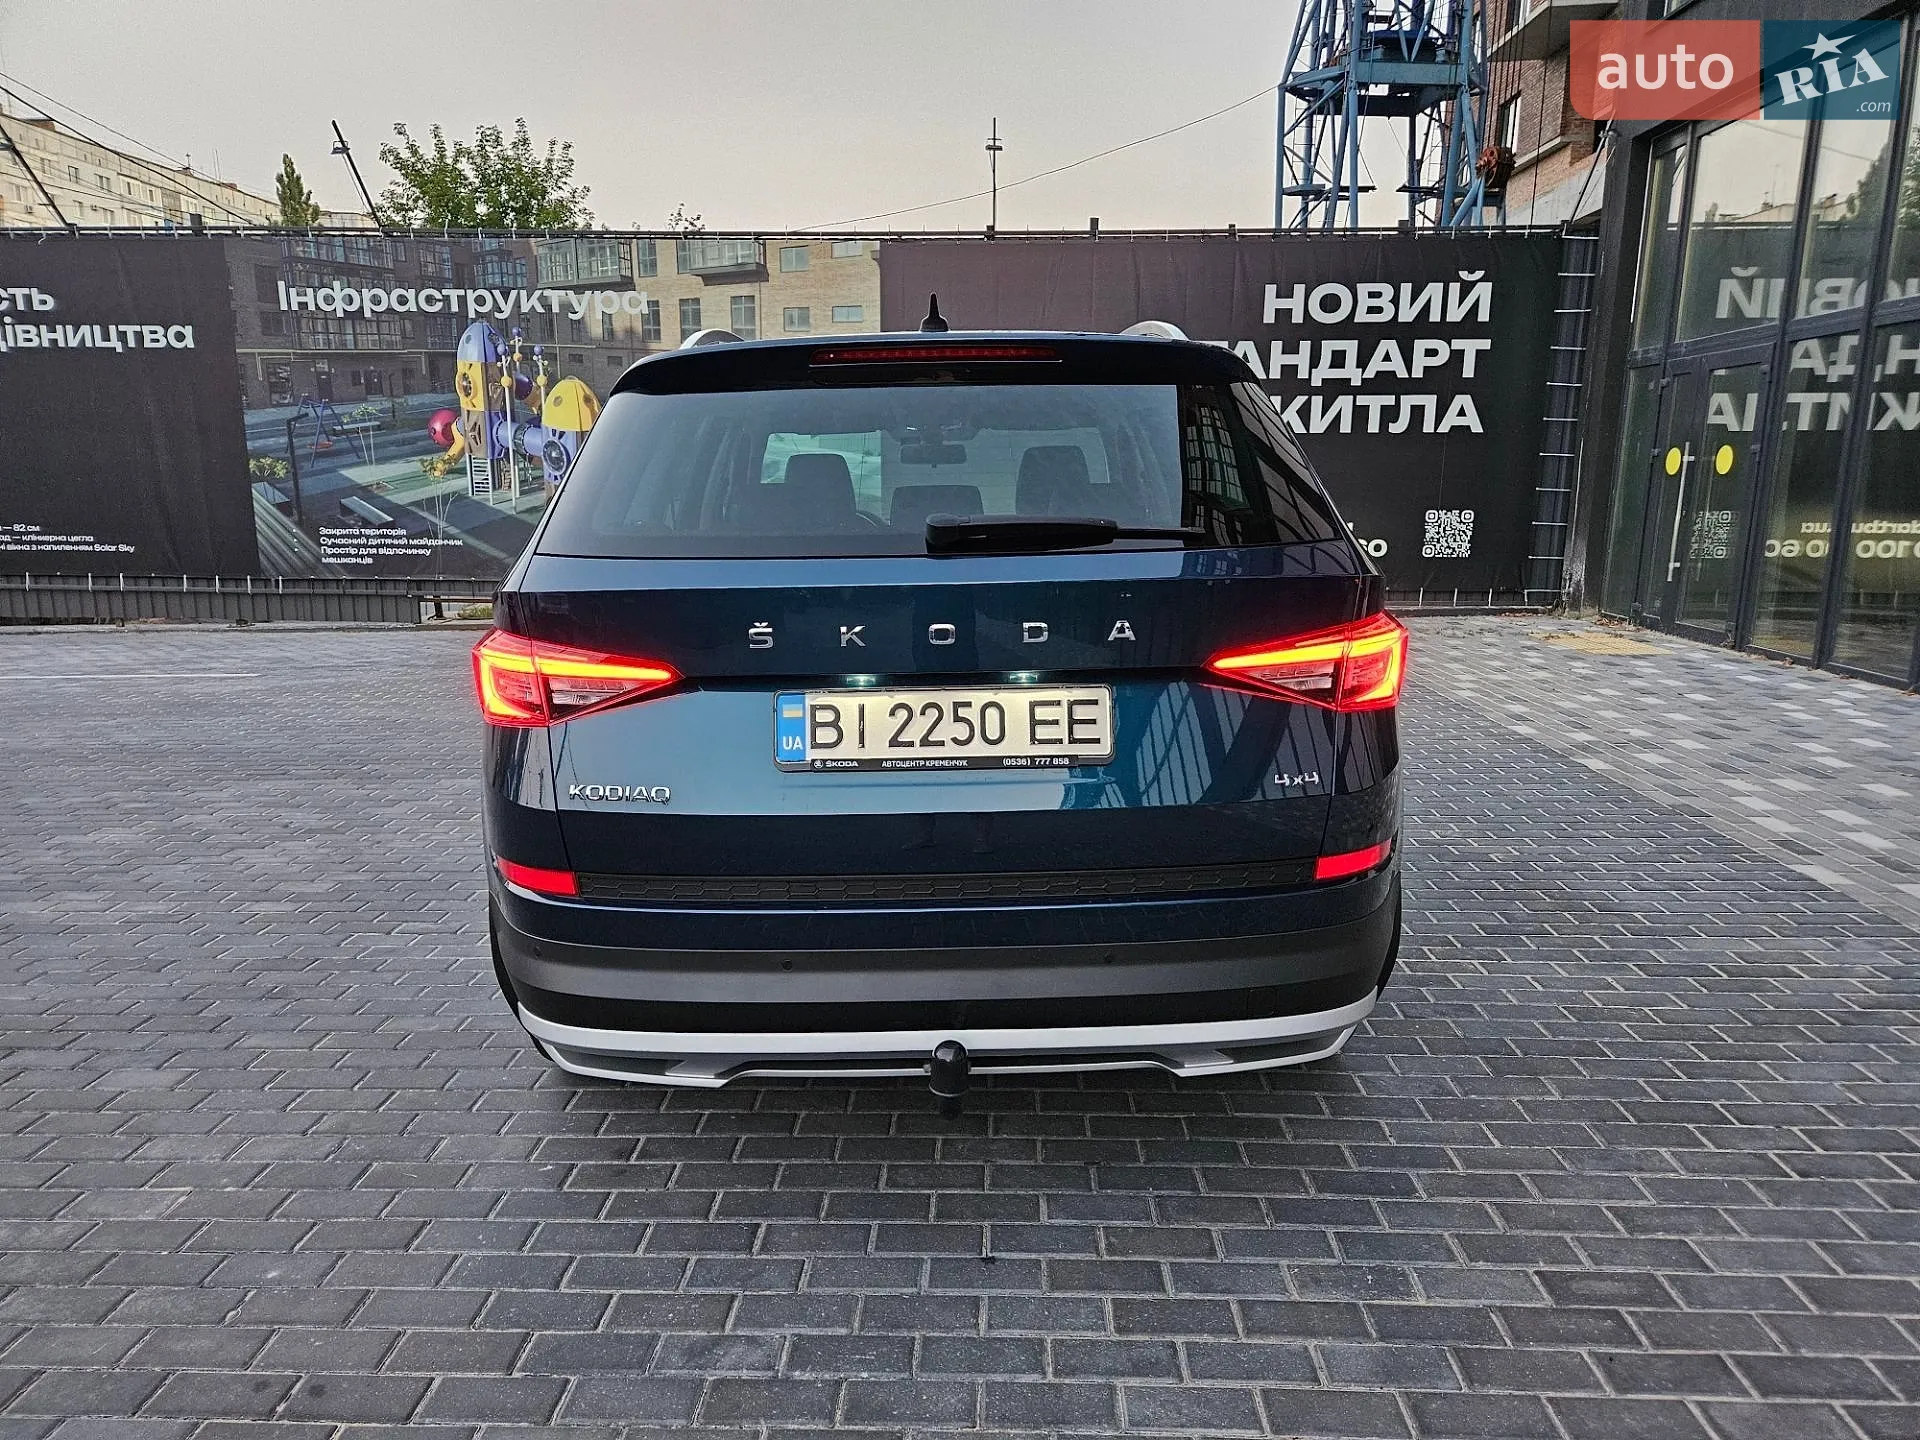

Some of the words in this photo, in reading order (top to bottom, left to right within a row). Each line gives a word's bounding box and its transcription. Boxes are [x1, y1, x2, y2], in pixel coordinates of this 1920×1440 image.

[277, 280, 649, 320] Інфраструктура
[1263, 270, 1492, 324] НОВИЙ
[1194, 339, 1491, 386] АНДАРТ
[13, 523, 26, 532] 82
[319, 527, 359, 537] Закрита
[360, 528, 407, 537] територія
[94, 543, 117, 552] Solar
[118, 543, 135, 553] Sky
[320, 536, 367, 546] Сучасний
[368, 537, 408, 546] дитячий
[409, 538, 463, 546] майданчик
[320, 546, 358, 555] Простір
[378, 547, 432, 556] відпочинку
[321, 556, 373, 564] мешканців
[748, 620, 1137, 649] ŠKODA
[810, 703, 865, 749] BI
[888, 701, 1005, 747] 2250
[1029, 699, 1100, 745] EE
[782, 736, 803, 750] UA
[881, 759, 925, 768] АВТОЦЕНТР
[925, 759, 968, 767] КРЕМЕНЧУК
[1034, 757, 1051, 765] 777
[1274, 771, 1320, 787] 4x4
[568, 784, 671, 806] KODIAQ
